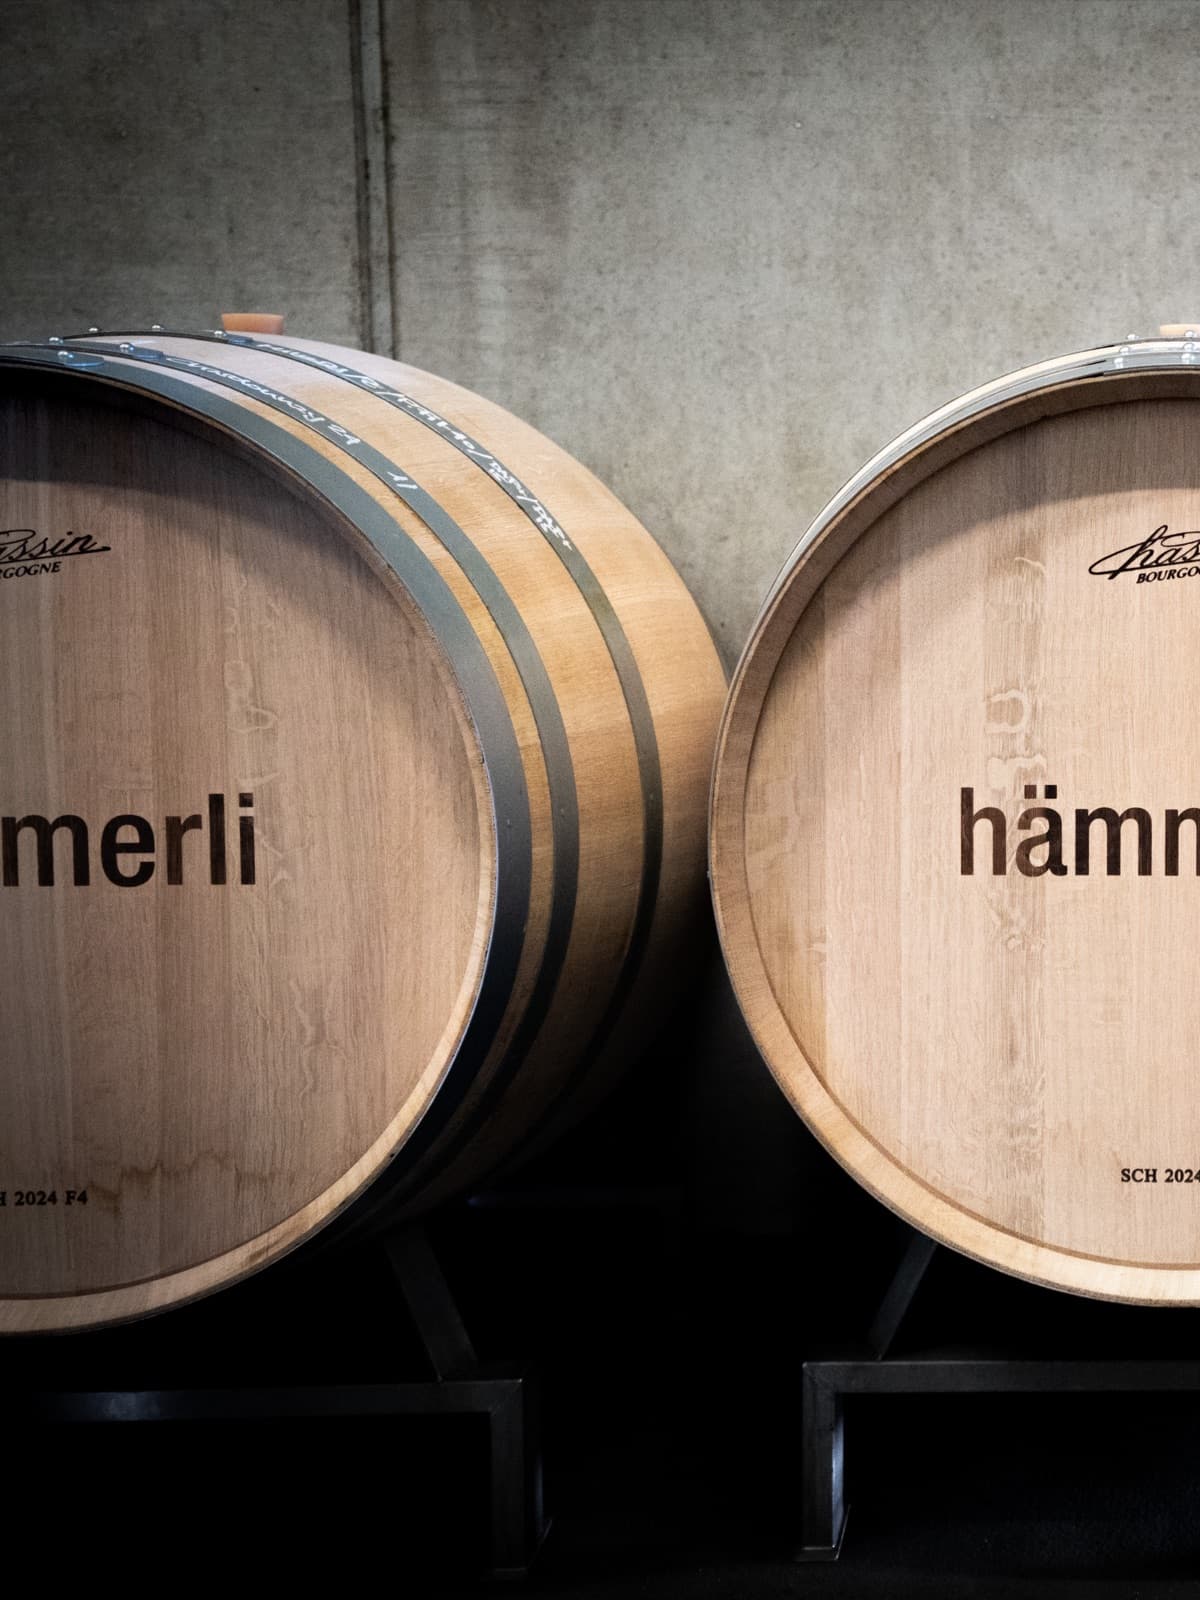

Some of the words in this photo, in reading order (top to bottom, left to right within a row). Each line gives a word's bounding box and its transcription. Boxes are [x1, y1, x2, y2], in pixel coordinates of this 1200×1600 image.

[0, 561, 62, 579] GOGNE
[1120, 1168, 1158, 1183] SCH
[14, 1190, 57, 1206] 2024
[65, 1190, 88, 1206] F4
